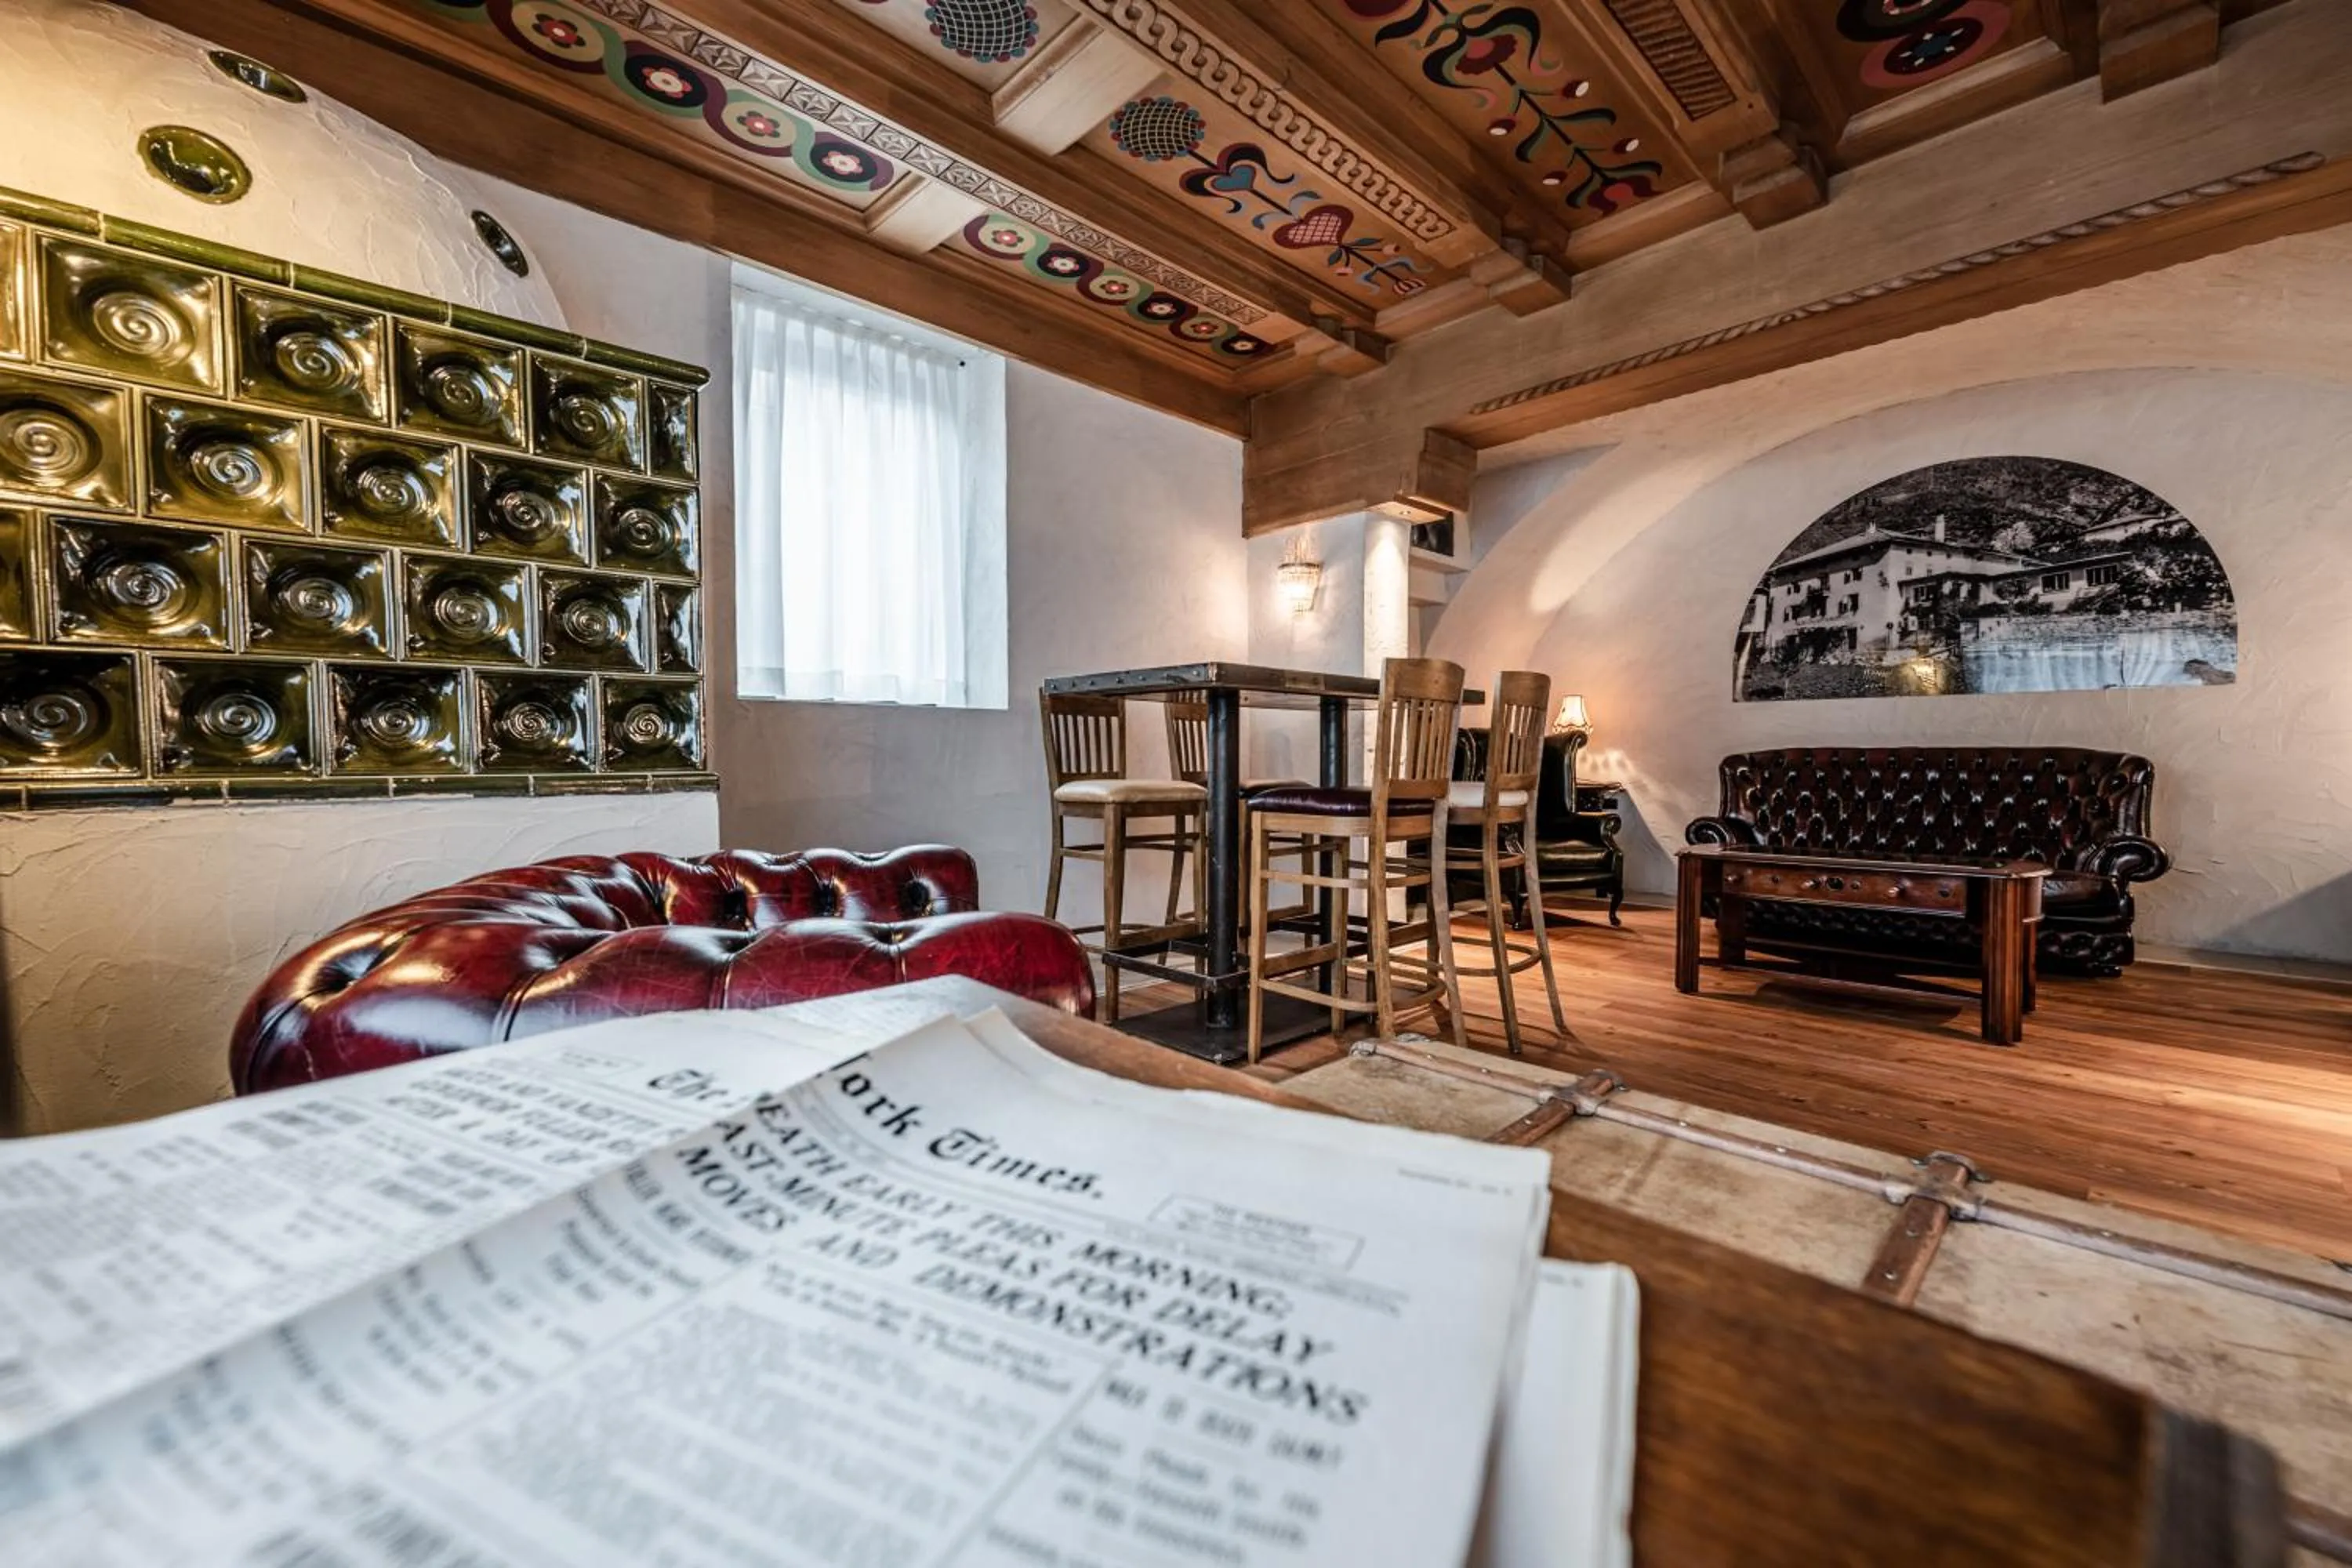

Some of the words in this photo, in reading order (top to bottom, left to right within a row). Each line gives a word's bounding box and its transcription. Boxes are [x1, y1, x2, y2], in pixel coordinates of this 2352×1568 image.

[815, 1051, 924, 1137] ork
[675, 1146, 799, 1233] MOVES
[804, 1231, 900, 1269] AND
[913, 1263, 1370, 1425] DEMONSTRATIONS
[712, 1118, 913, 1239] AST-MINUTE
[909, 1225, 1055, 1282] PLEAS
[1049, 1263, 1151, 1310] FOR
[1152, 1294, 1334, 1366] DELAY
[838, 1173, 970, 1221] EARLY
[970, 1210, 1065, 1251] THIS
